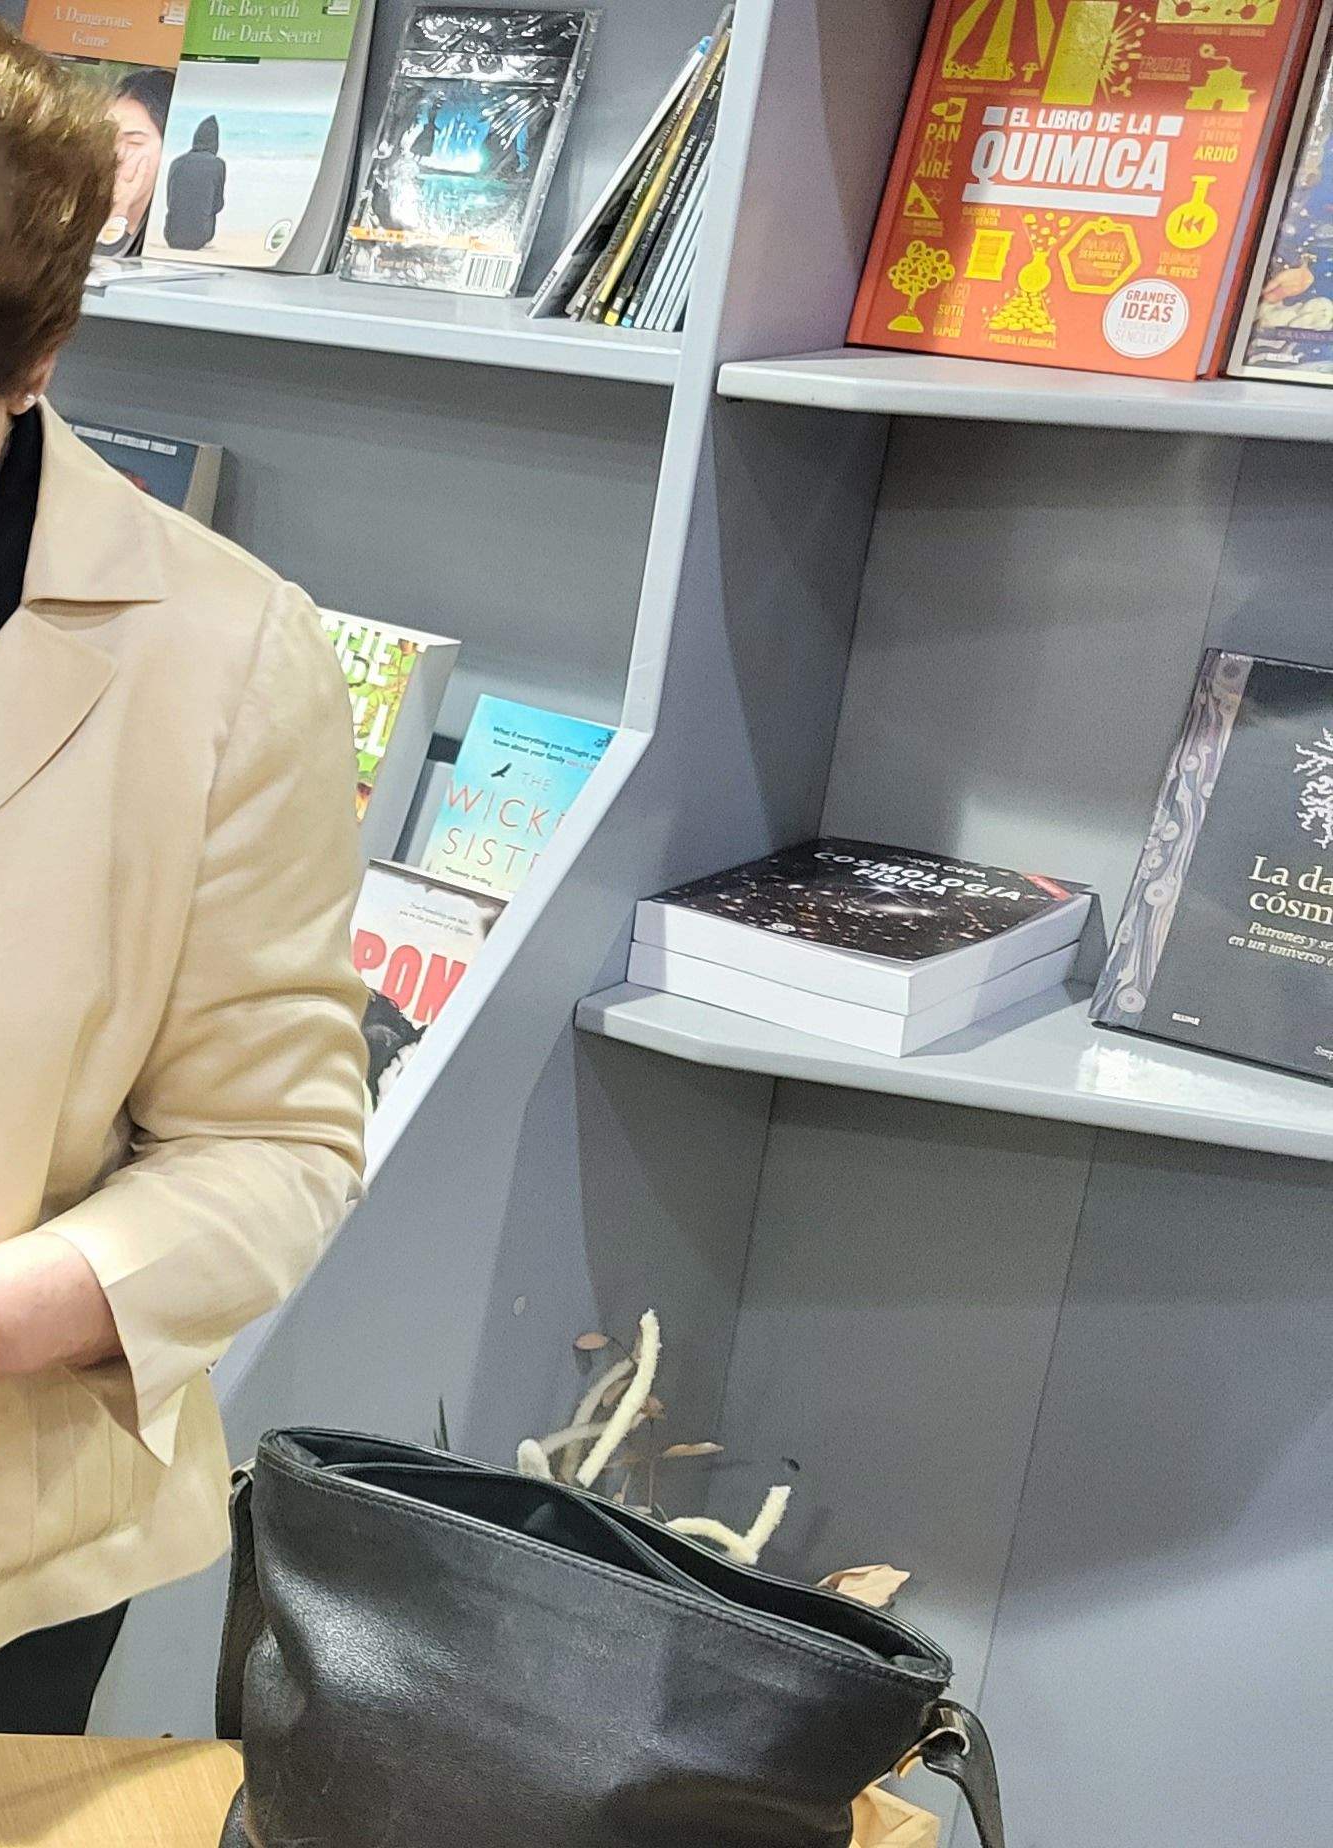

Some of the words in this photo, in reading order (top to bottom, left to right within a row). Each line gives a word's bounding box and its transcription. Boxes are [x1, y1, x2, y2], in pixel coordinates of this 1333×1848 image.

[66, 6, 133, 28] Dangerous
[209, 0, 231, 16] The
[239, 0, 263, 21] Boy
[270, 0, 299, 18] with
[72, 28, 109, 47] Game
[212, 24, 232, 41] the
[240, 24, 273, 43] Dark
[278, 26, 322, 44] Secret
[1009, 107, 1031, 127] EL
[1036, 109, 1093, 131] LIBRO
[1096, 112, 1124, 133] DE
[1126, 114, 1153, 135] LA
[925, 122, 961, 142] PAN
[971, 130, 1169, 191] QUIMICA
[1192, 144, 1239, 163] ARDIÓ
[915, 160, 952, 179] AIRE
[1126, 289, 1177, 305] GRANDES
[937, 304, 966, 317] SUTIL
[1121, 302, 1174, 323] IDEAS
[933, 327, 961, 338] VAPOR
[522, 772, 552, 791] THE
[813, 851, 1022, 902] COSMOLOGÍA
[1248, 855, 1290, 887] La
[852, 868, 948, 897] FÍSICA
[1249, 890, 1333, 926] cósm
[1249, 922, 1306, 945] Patrones
[1228, 935, 1245, 948] en
[1247, 938, 1266, 951] un
[1269, 944, 1325, 964] universo
